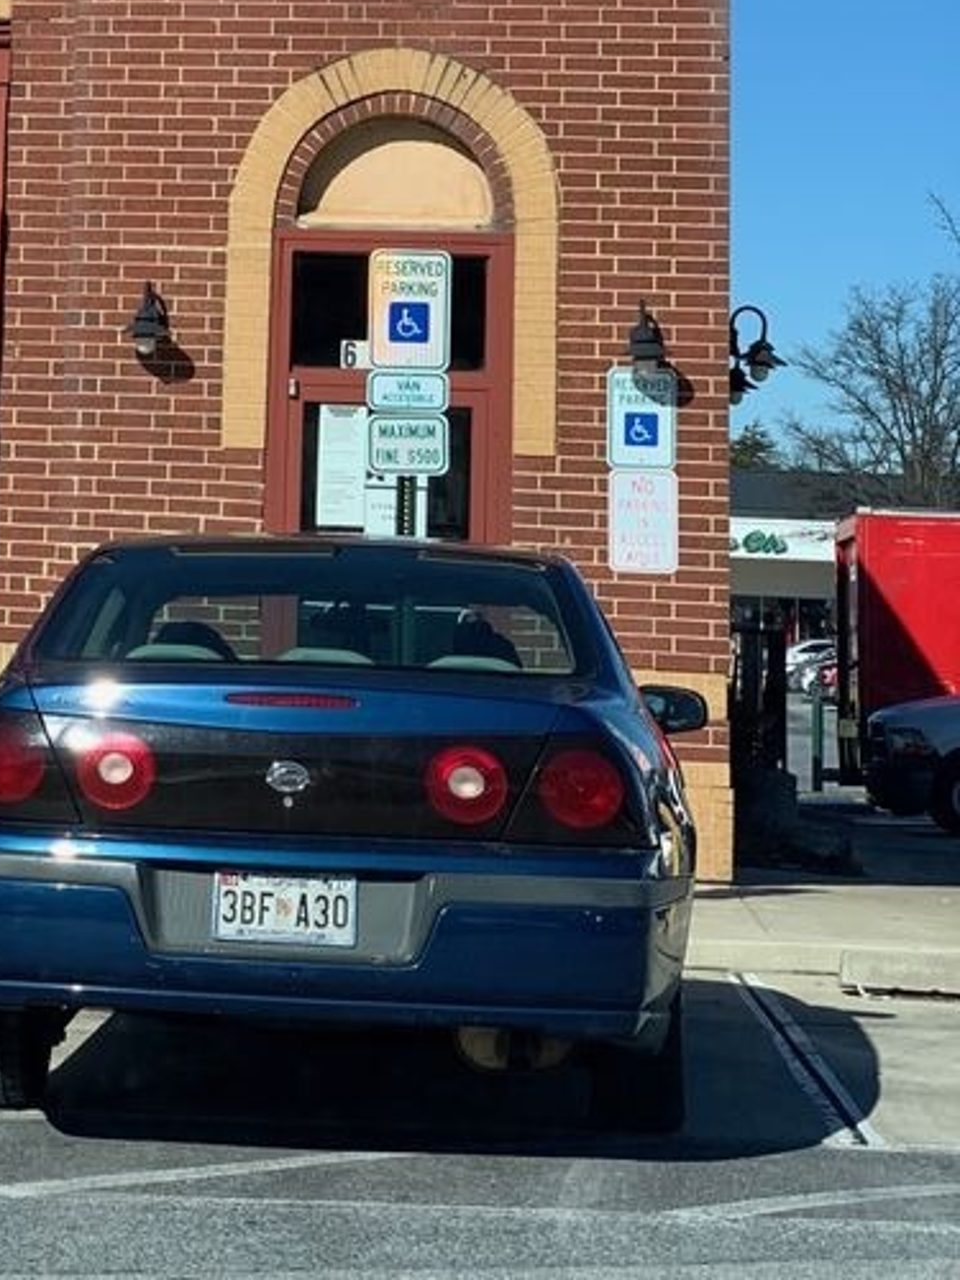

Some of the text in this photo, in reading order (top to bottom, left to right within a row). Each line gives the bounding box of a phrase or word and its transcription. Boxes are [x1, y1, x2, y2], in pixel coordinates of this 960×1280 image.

[375, 261, 444, 278] RESERVED
[381, 281, 439, 297] PARKING
[396, 381, 421, 392] VAN
[379, 424, 437, 438] MAXIMUM
[376, 448, 400, 464] FINE
[221, 890, 350, 929] 3BF A30
